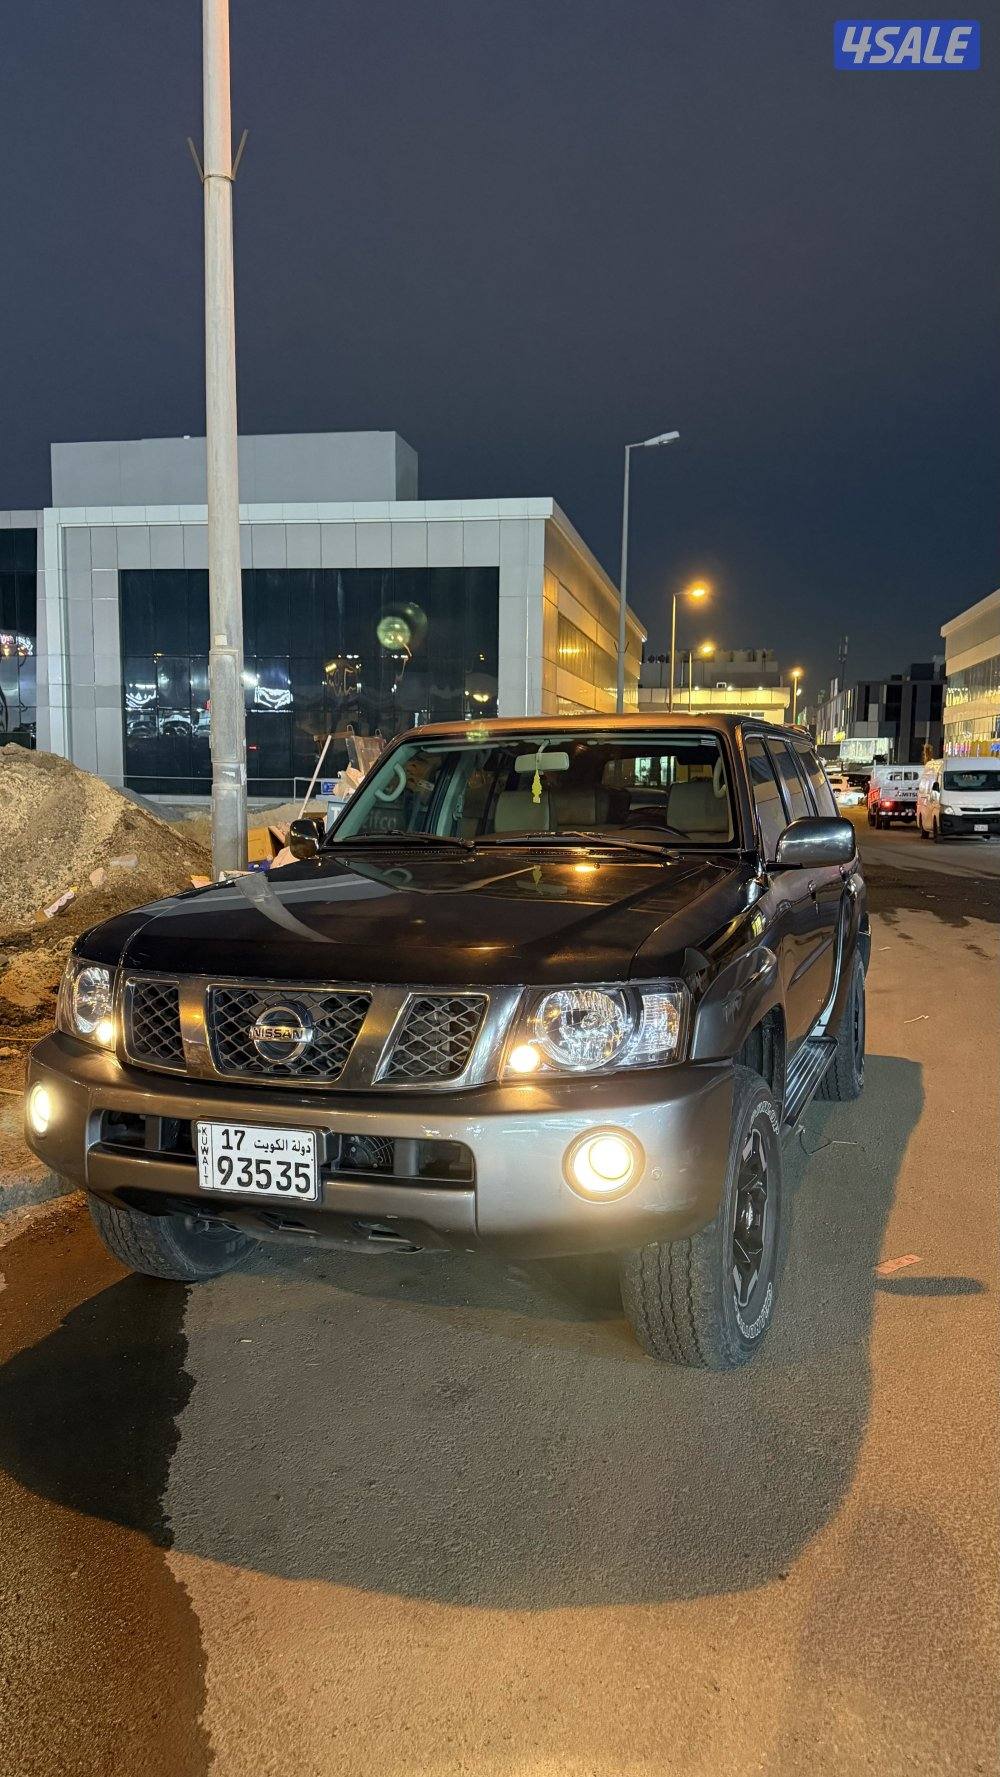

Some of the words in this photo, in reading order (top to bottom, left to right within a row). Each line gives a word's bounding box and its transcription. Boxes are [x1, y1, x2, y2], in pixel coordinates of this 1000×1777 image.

[252, 1027, 304, 1039] NISSAN
[221, 1128, 246, 1151] 17
[253, 1138, 288, 1153] الكويت
[291, 1140, 311, 1156] دولة
[200, 1126, 209, 1184] KUWAIT
[217, 1155, 311, 1194] 93535
